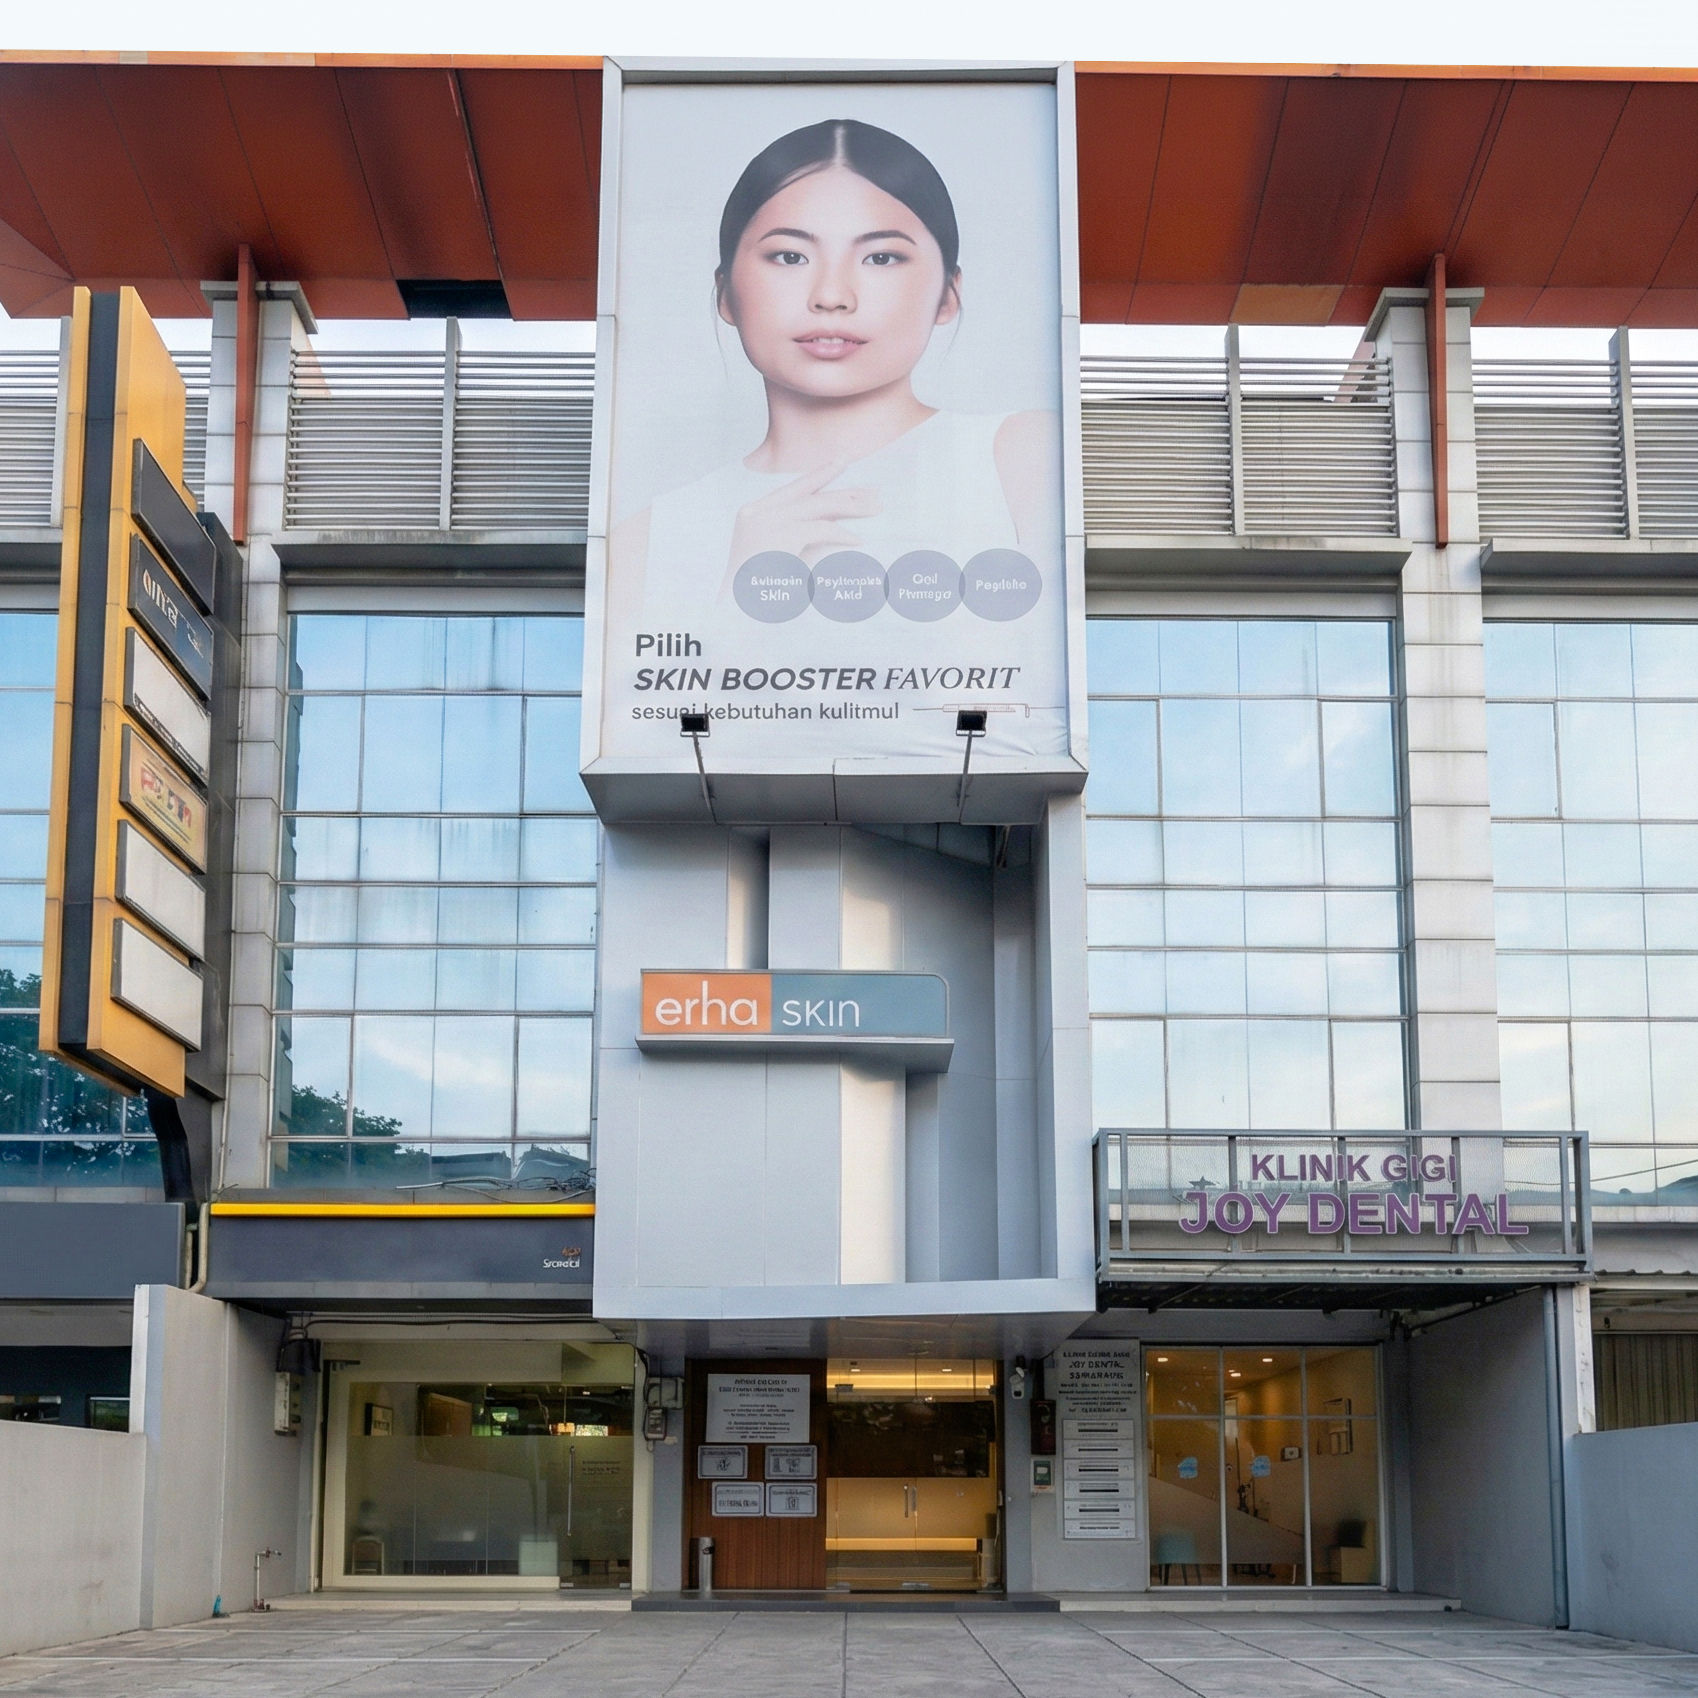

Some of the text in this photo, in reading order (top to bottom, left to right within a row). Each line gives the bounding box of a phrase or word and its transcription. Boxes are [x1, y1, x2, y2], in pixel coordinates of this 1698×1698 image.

[635, 633, 703, 657] Pilih
[634, 666, 1021, 691] SKIN BOOSTER FAVORIT
[704, 702, 813, 720] kebutuhan
[655, 980, 758, 1027] erha
[1251, 1153, 1458, 1183] KLINIK GIGI
[1178, 1190, 1530, 1236] JOY DENTAL
